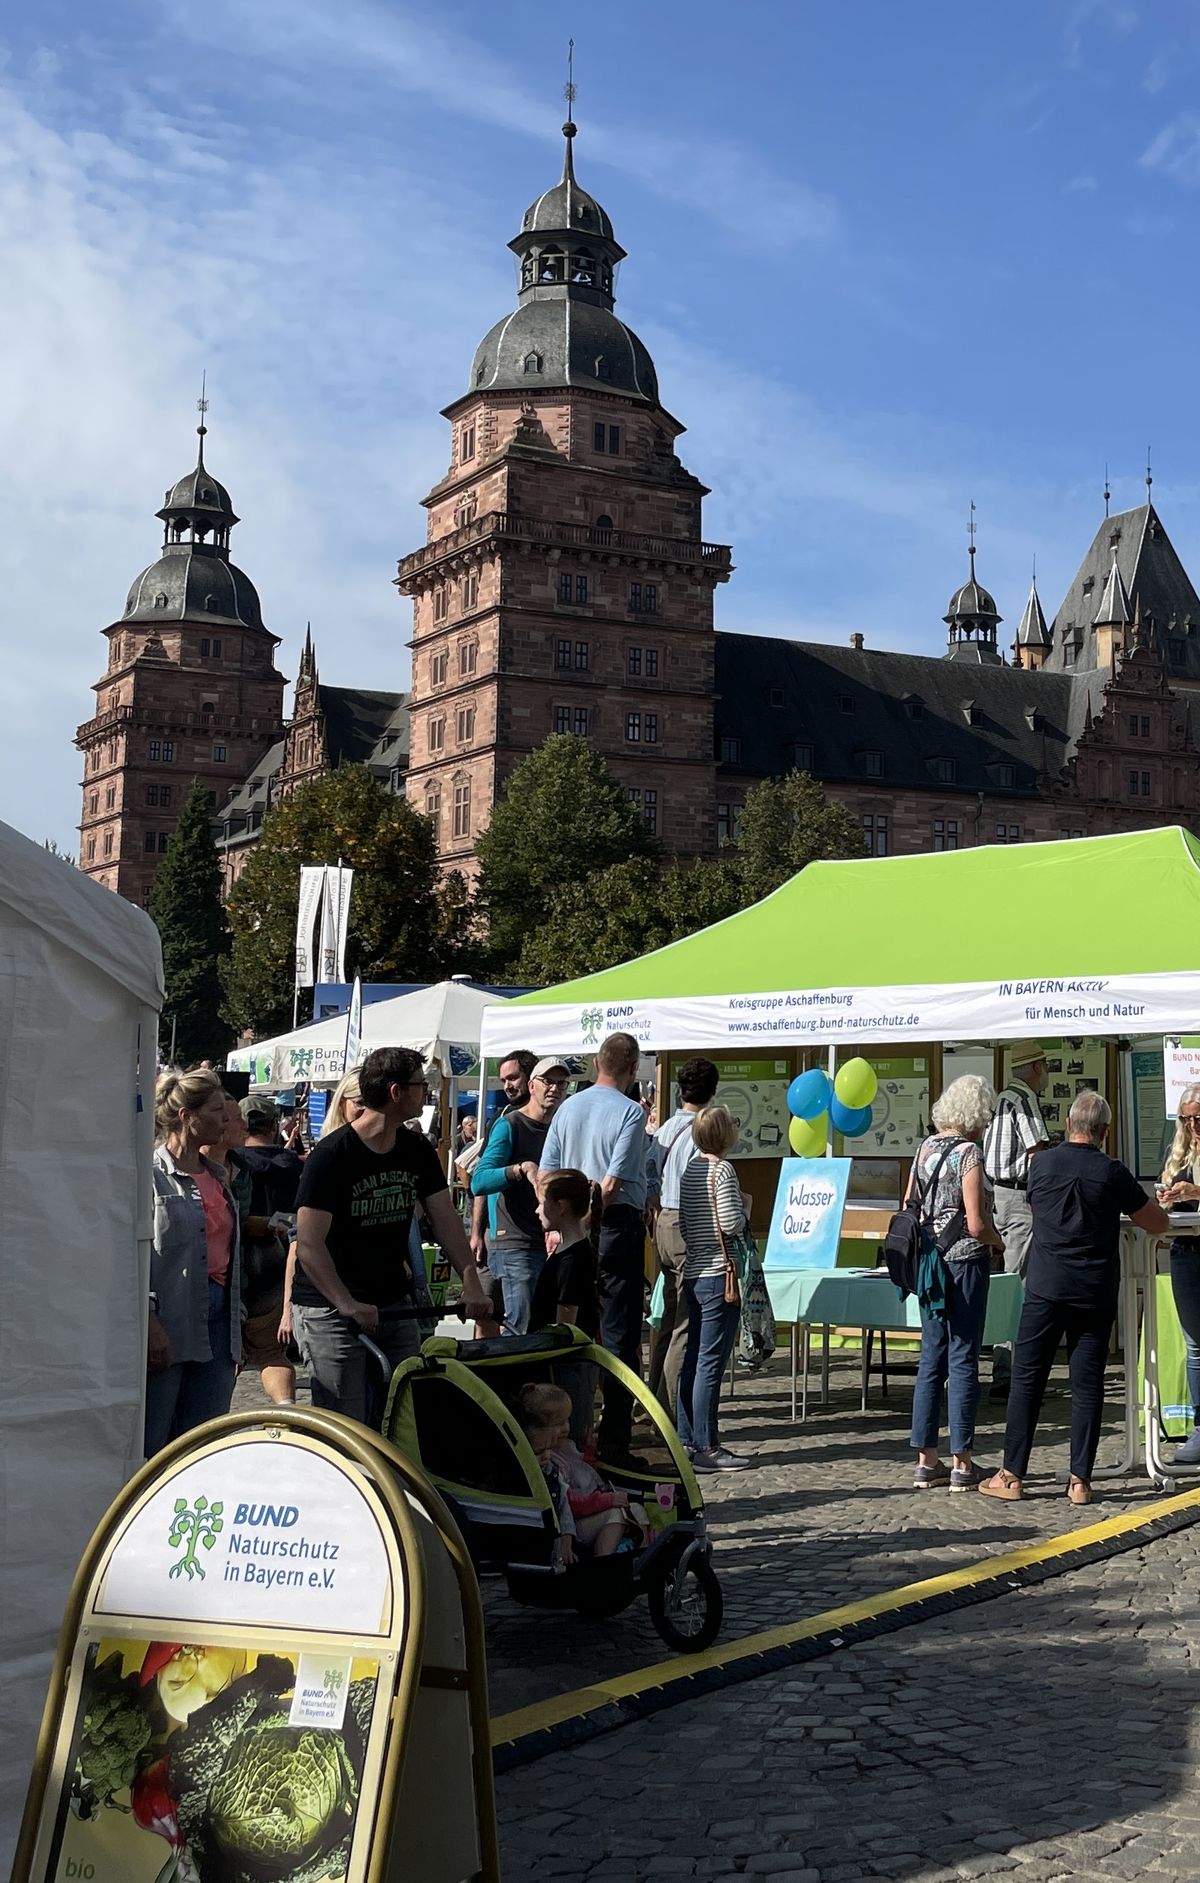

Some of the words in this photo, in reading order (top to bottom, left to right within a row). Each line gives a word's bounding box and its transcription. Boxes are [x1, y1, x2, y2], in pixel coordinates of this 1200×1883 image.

[999, 983, 1012, 996] IN
[1015, 980, 1064, 995] BAYERN
[1067, 980, 1109, 992] AKTIV
[729, 998, 783, 1010] Kreisgruppe
[785, 993, 853, 1006] Aschaffenburg
[606, 1006, 634, 1017] BUND
[1025, 1007, 1041, 1019] für
[1043, 1005, 1086, 1018] Mensch
[1089, 1004, 1110, 1017] und
[1113, 1003, 1145, 1016] Natur
[606, 1019, 651, 1030] Naturschutz
[728, 1013, 920, 1031] www.aschaffenburg.bund-naturschutz.de
[1172, 1053, 1193, 1061] BUND
[352, 1175, 378, 1197] JEAN
[789, 1184, 834, 1206] Wasser
[783, 1215, 811, 1235] Quiz
[233, 1503, 299, 1528] BUND
[228, 1534, 340, 1560] Naturschutz
[224, 1561, 239, 1581] in
[244, 1563, 303, 1589] Bayern
[308, 1568, 336, 1589] e.V.
[302, 1689, 323, 1698] BUND
[301, 1700, 337, 1709] Naturschutz
[305, 1708, 325, 1717] Bayern
[65, 1856, 95, 1880] bio
